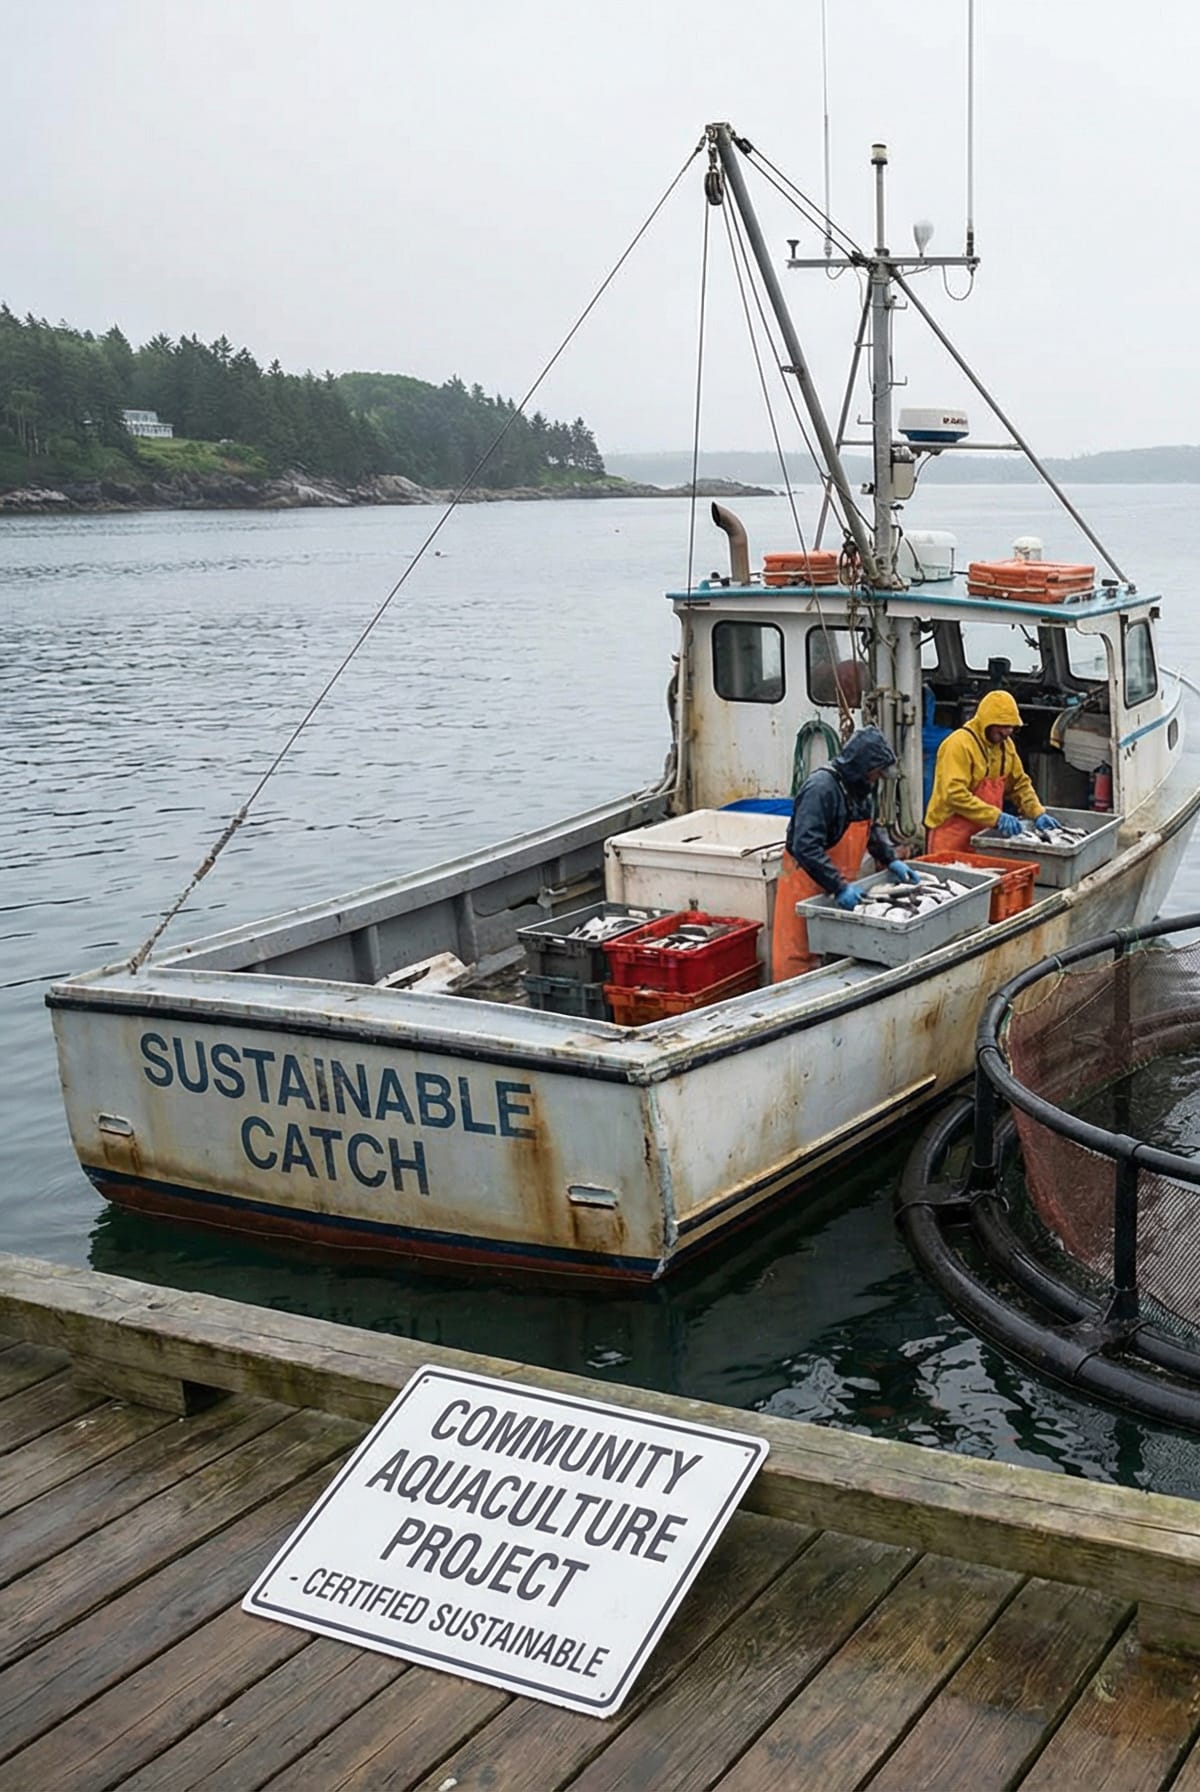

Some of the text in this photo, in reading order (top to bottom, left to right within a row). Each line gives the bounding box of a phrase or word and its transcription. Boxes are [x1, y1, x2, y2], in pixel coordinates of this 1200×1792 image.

[139, 1031, 537, 1140] SUSTAINABLE
[240, 1115, 431, 1197] CATCH
[430, 1399, 704, 1495] COMMUNITY
[364, 1448, 689, 1563] AQUACULTURE
[379, 1517, 591, 1608] PROJECT
[302, 1566, 431, 1626] CERTIFIED
[428, 1602, 612, 1678] SUSTAINABLE
